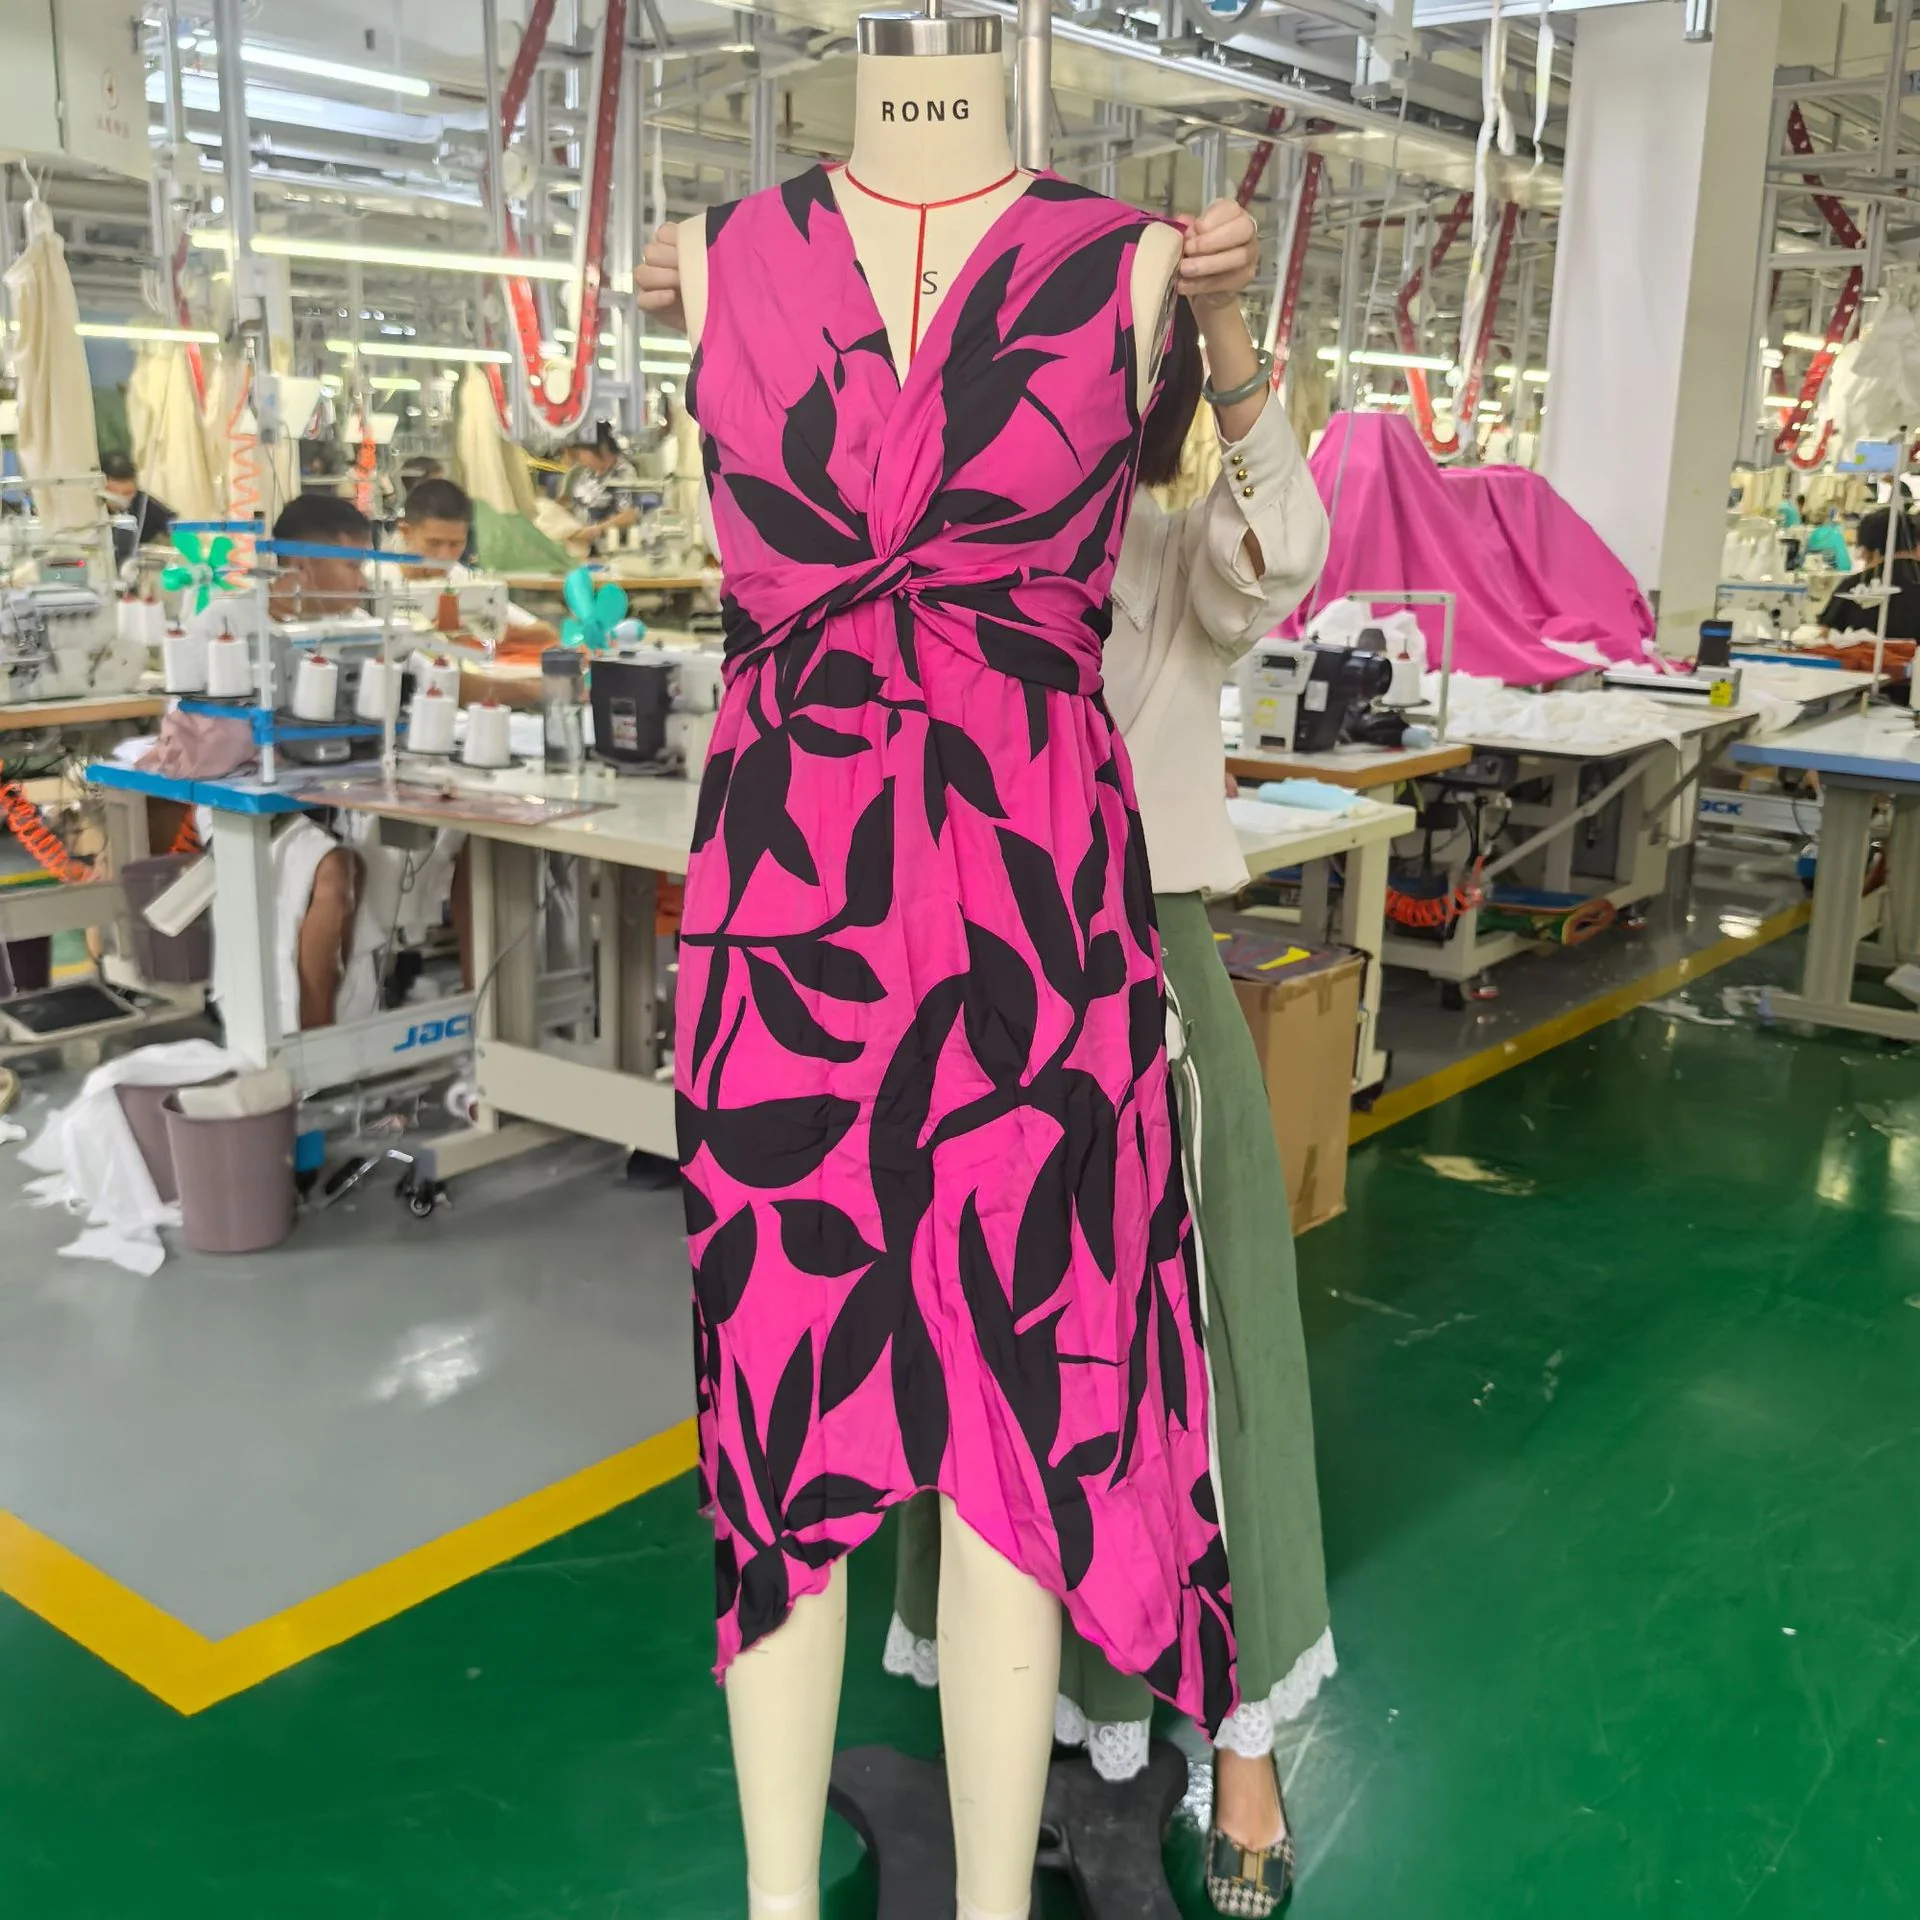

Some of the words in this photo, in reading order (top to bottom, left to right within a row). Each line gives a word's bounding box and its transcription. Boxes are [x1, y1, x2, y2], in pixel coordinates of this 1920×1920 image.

[882, 99, 969, 122] RONG
[922, 271, 938, 295] S
[393, 1014, 472, 1052] JAC
